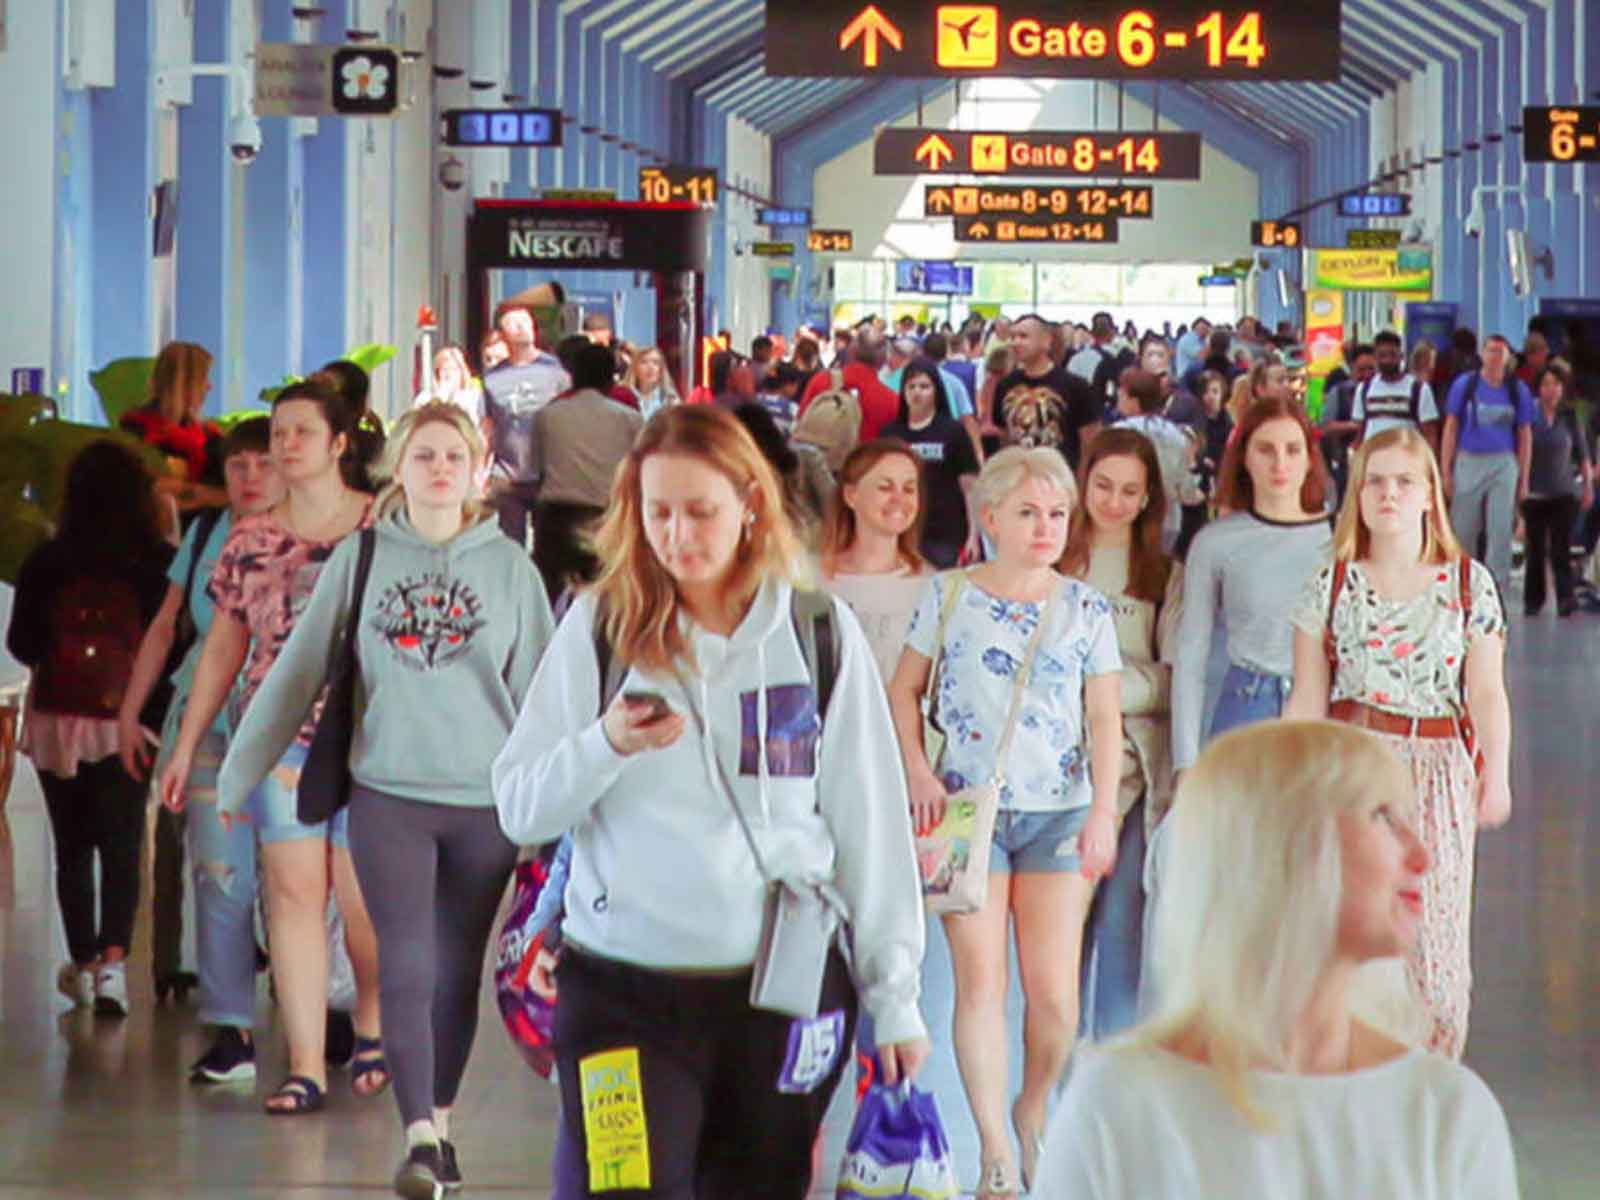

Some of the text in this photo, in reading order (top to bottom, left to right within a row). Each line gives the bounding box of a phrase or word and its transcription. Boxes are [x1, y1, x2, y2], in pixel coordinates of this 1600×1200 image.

[1008, 21, 1106, 58] Gate
[1010, 142, 1068, 168] Gate
[1551, 123, 1600, 160] 6-
[640, 175, 714, 205] 10-11
[1076, 190, 1150, 214] 12-14
[1051, 222, 1105, 240] 12-14
